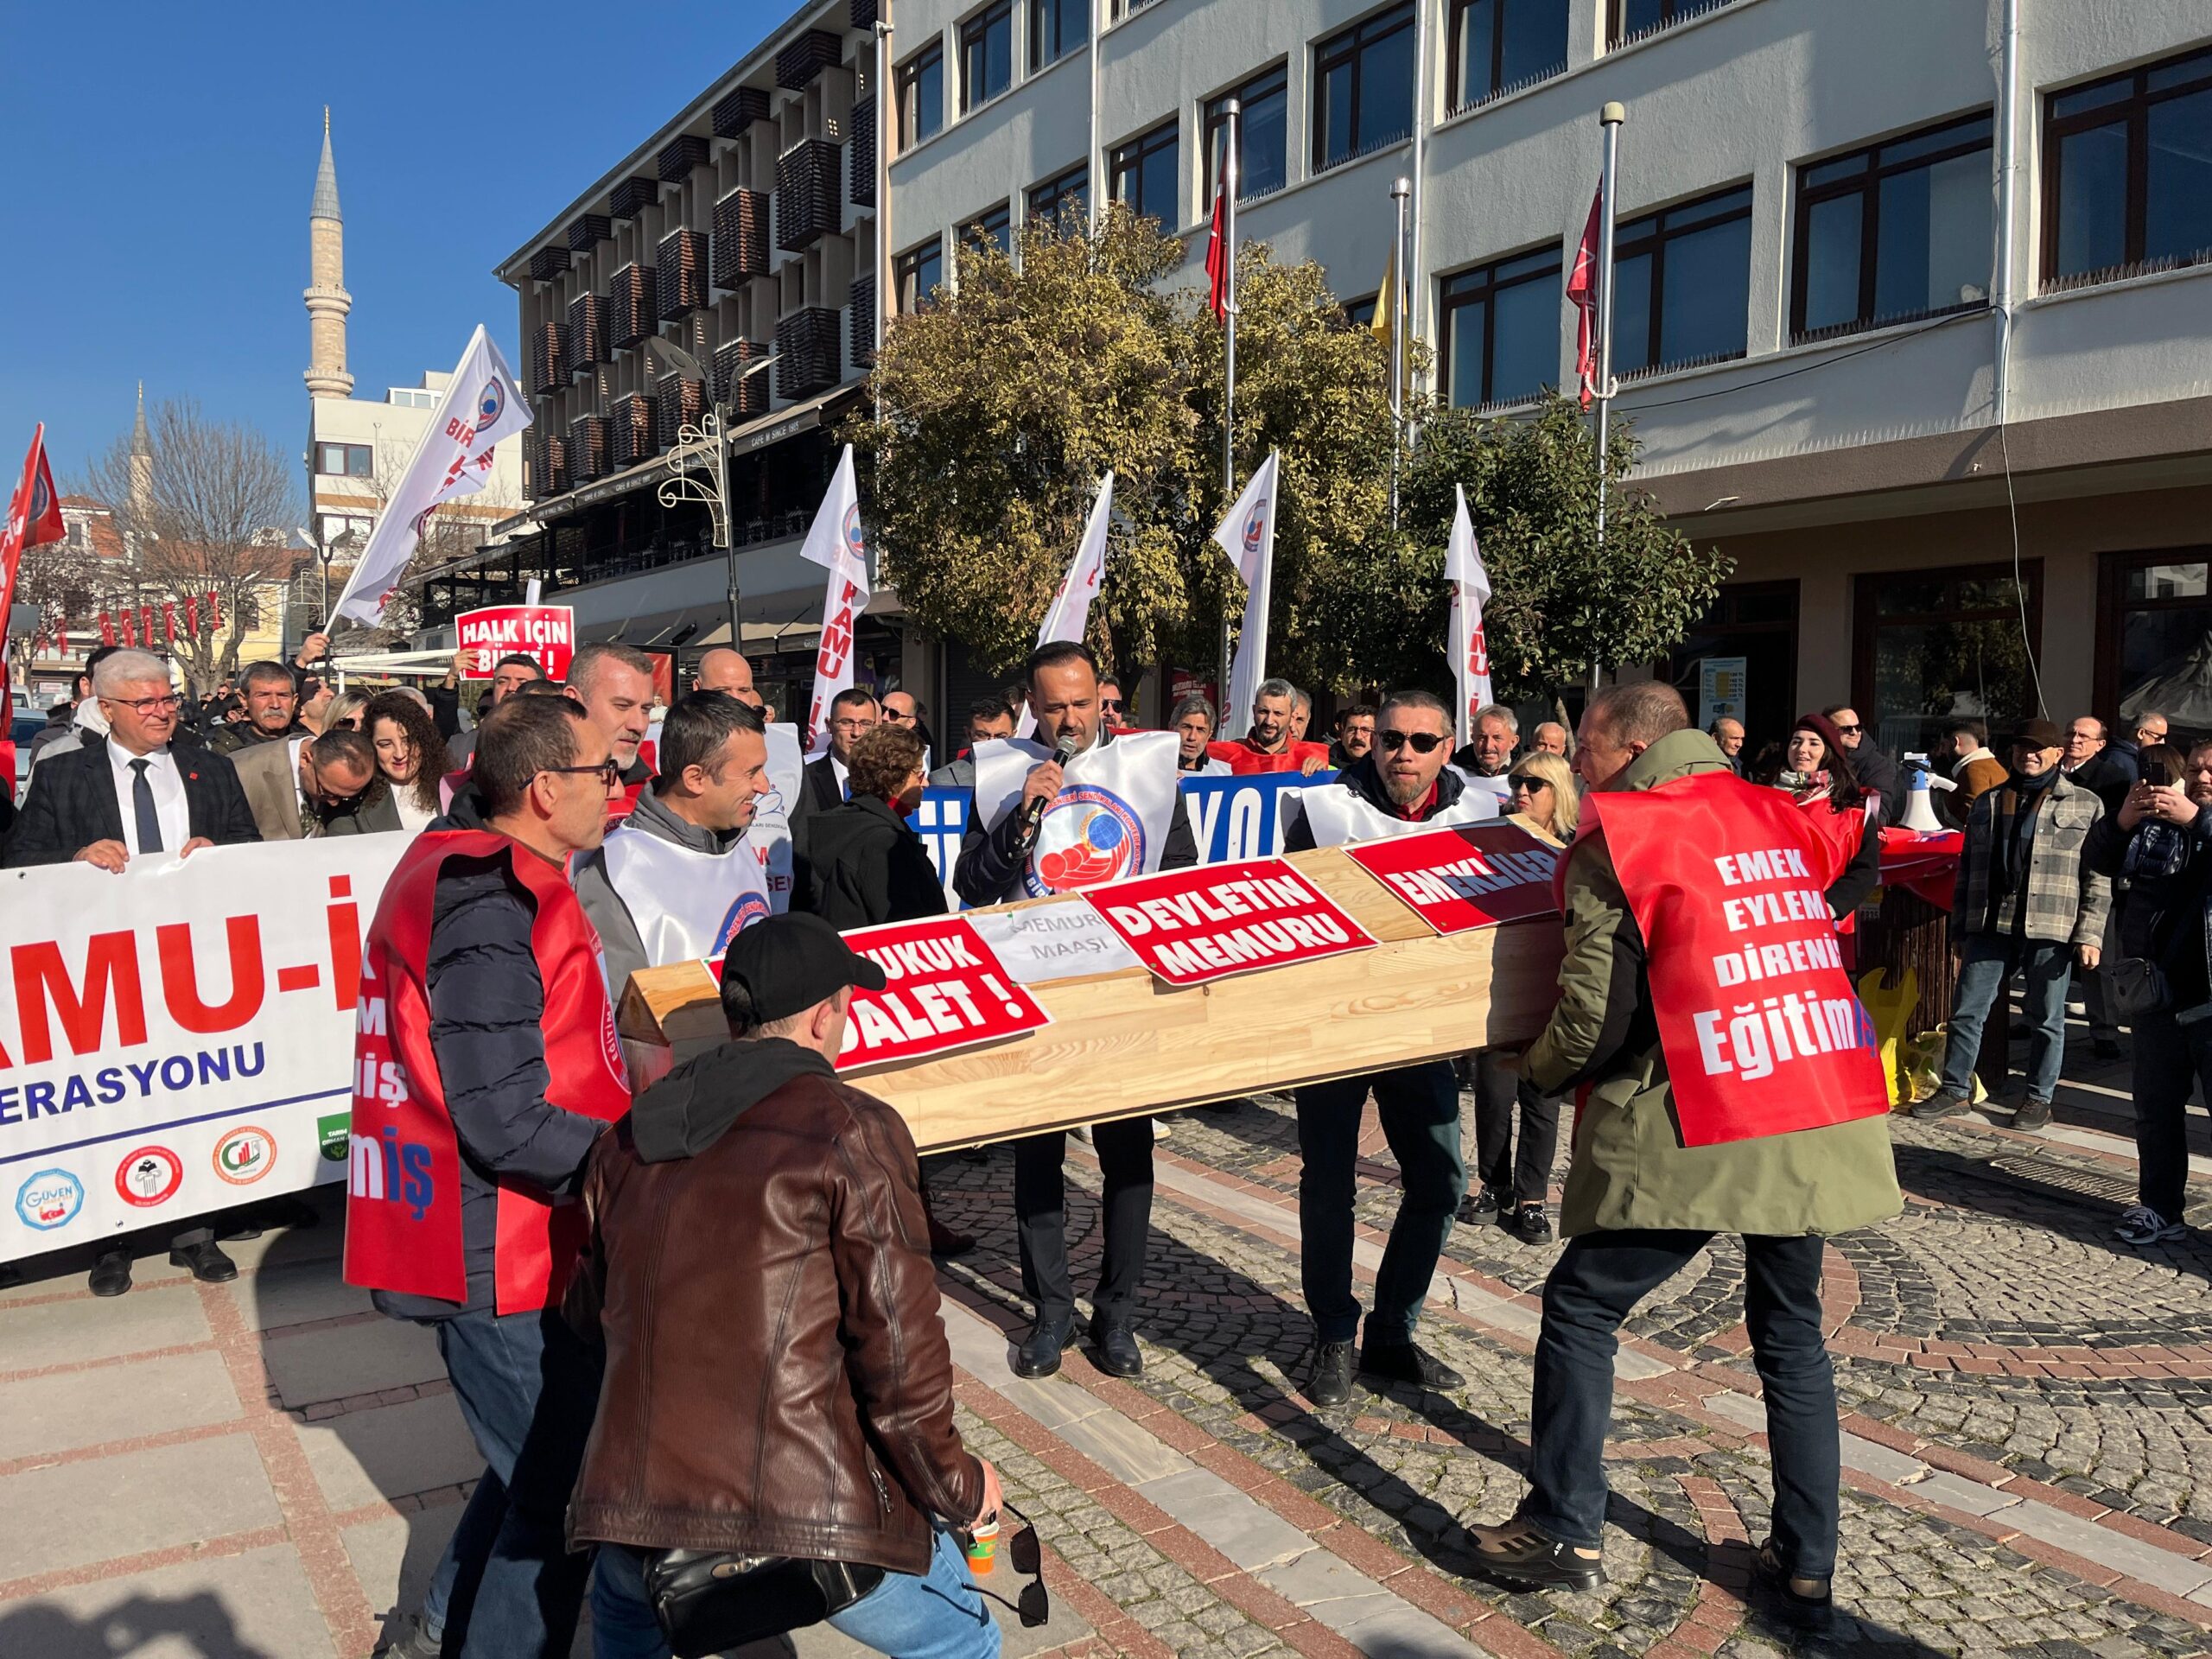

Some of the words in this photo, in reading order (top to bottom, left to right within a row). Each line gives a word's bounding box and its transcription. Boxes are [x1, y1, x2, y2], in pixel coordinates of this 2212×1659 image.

[462, 619, 519, 645] HALK
[524, 613, 567, 650] İÇİN
[1077, 791, 1123, 816] SENDİKALARI
[1714, 849, 1811, 887] EMEK
[1105, 870, 1317, 938] DEVLETİN
[1722, 890, 1827, 932] EYLEM
[1030, 937, 1109, 960] MAAŞI
[1151, 912, 1351, 977] MEMURU
